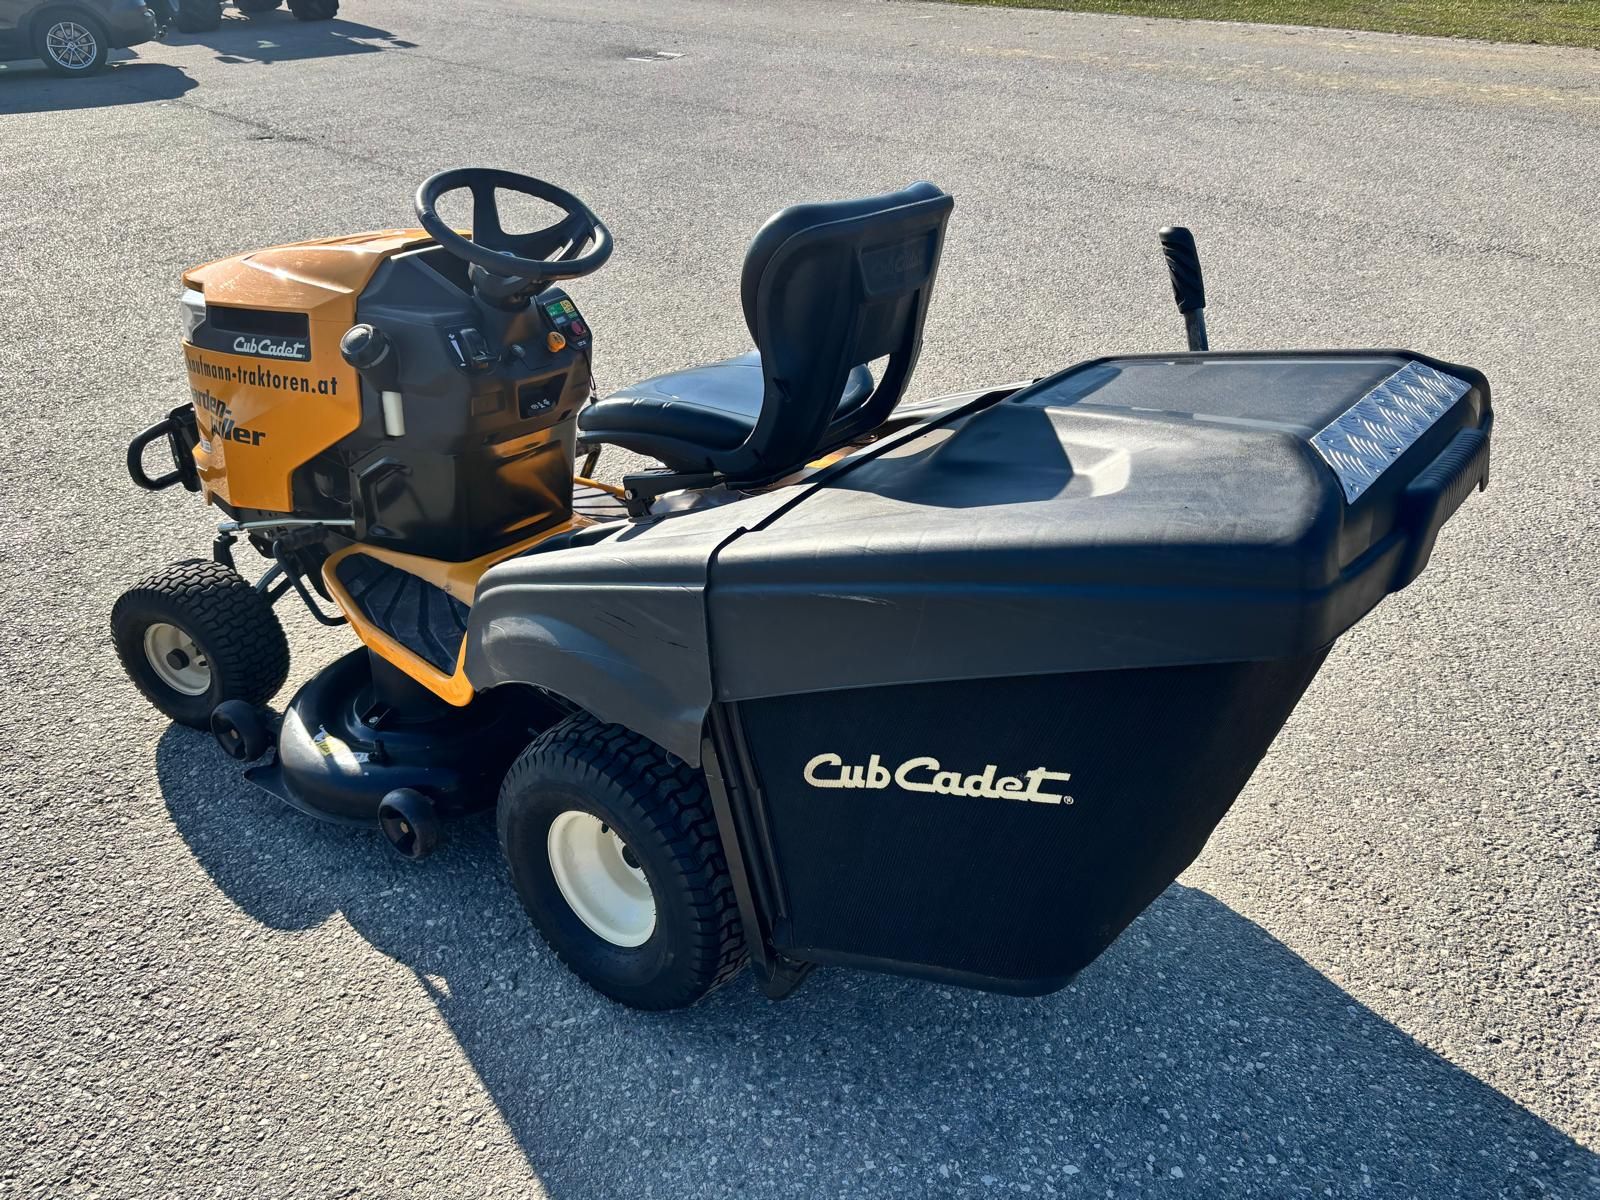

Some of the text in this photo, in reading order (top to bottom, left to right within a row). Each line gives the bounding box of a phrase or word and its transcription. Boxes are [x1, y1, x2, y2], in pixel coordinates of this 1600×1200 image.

[233, 336, 305, 359] Cub Cadet
[803, 752, 892, 789] Cub
